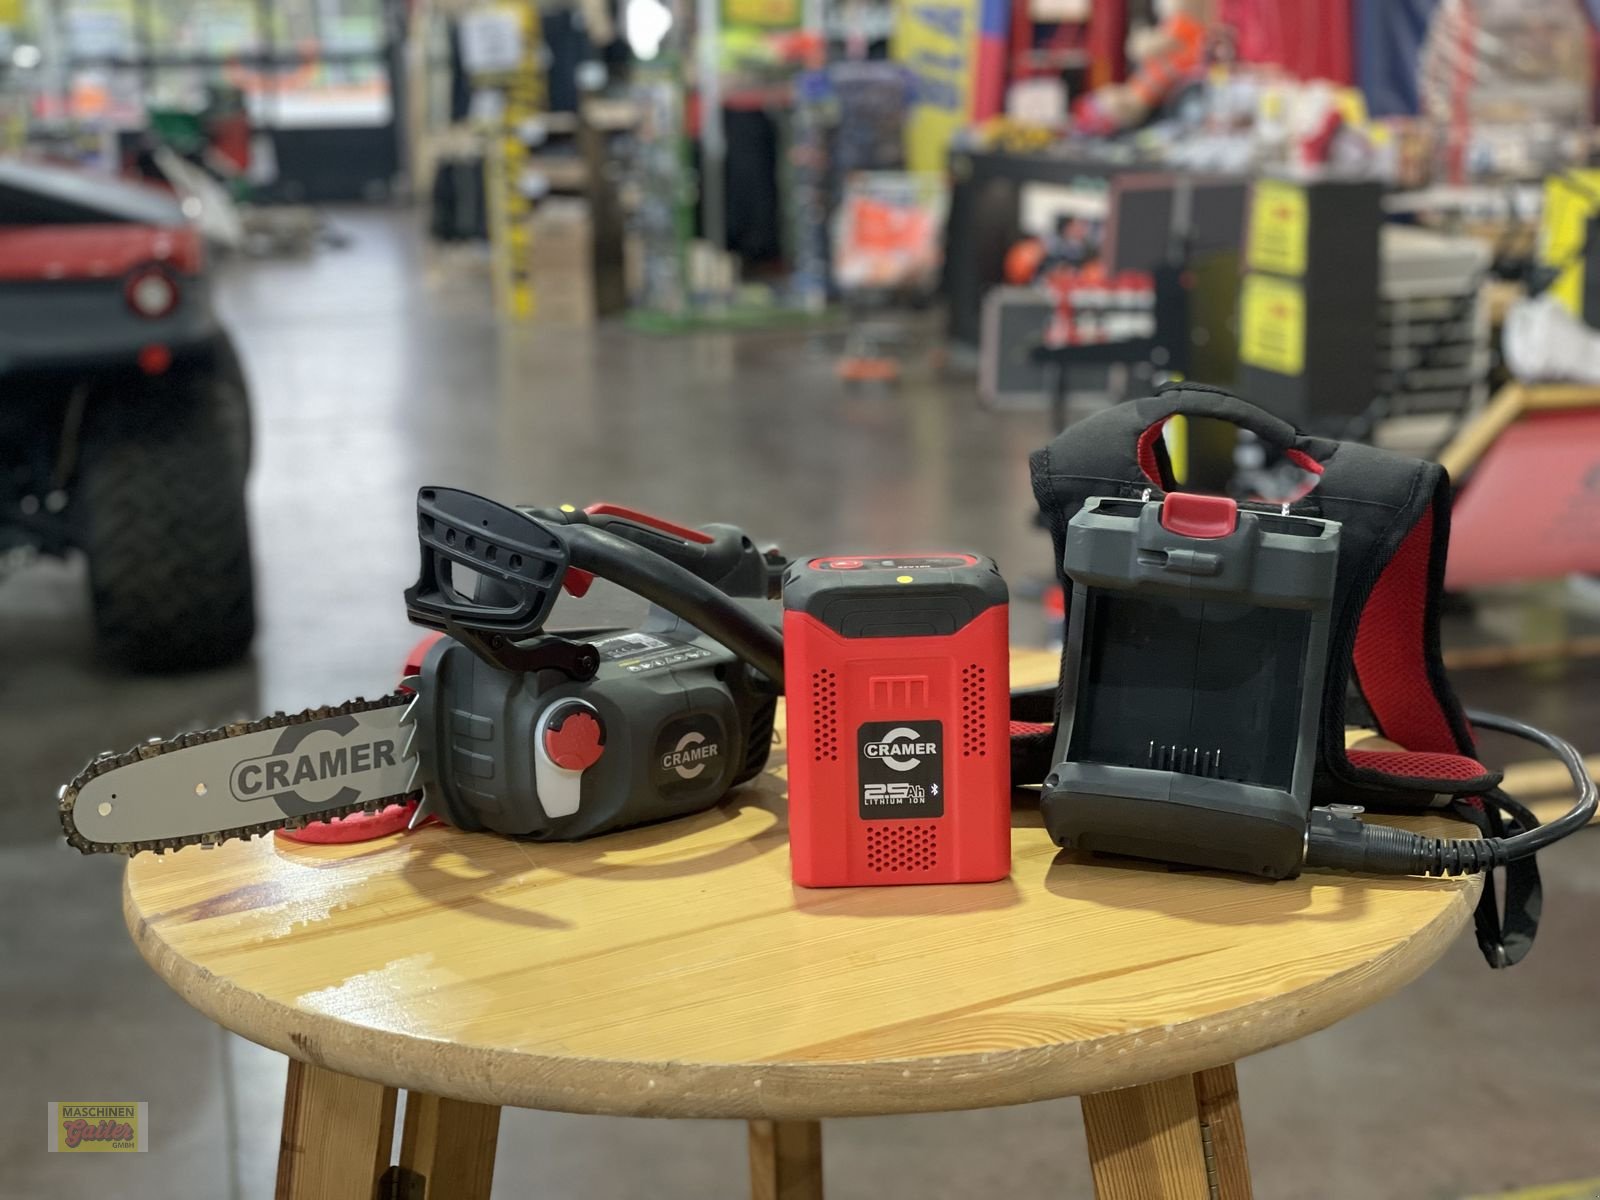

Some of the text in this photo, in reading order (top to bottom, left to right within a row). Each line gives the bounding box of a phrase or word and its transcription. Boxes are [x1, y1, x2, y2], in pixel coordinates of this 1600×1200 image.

[663, 743, 718, 768] CRAMER
[866, 742, 937, 756] CRAMER
[237, 739, 396, 795] CRAMER
[864, 798, 903, 806] LITHIUM
